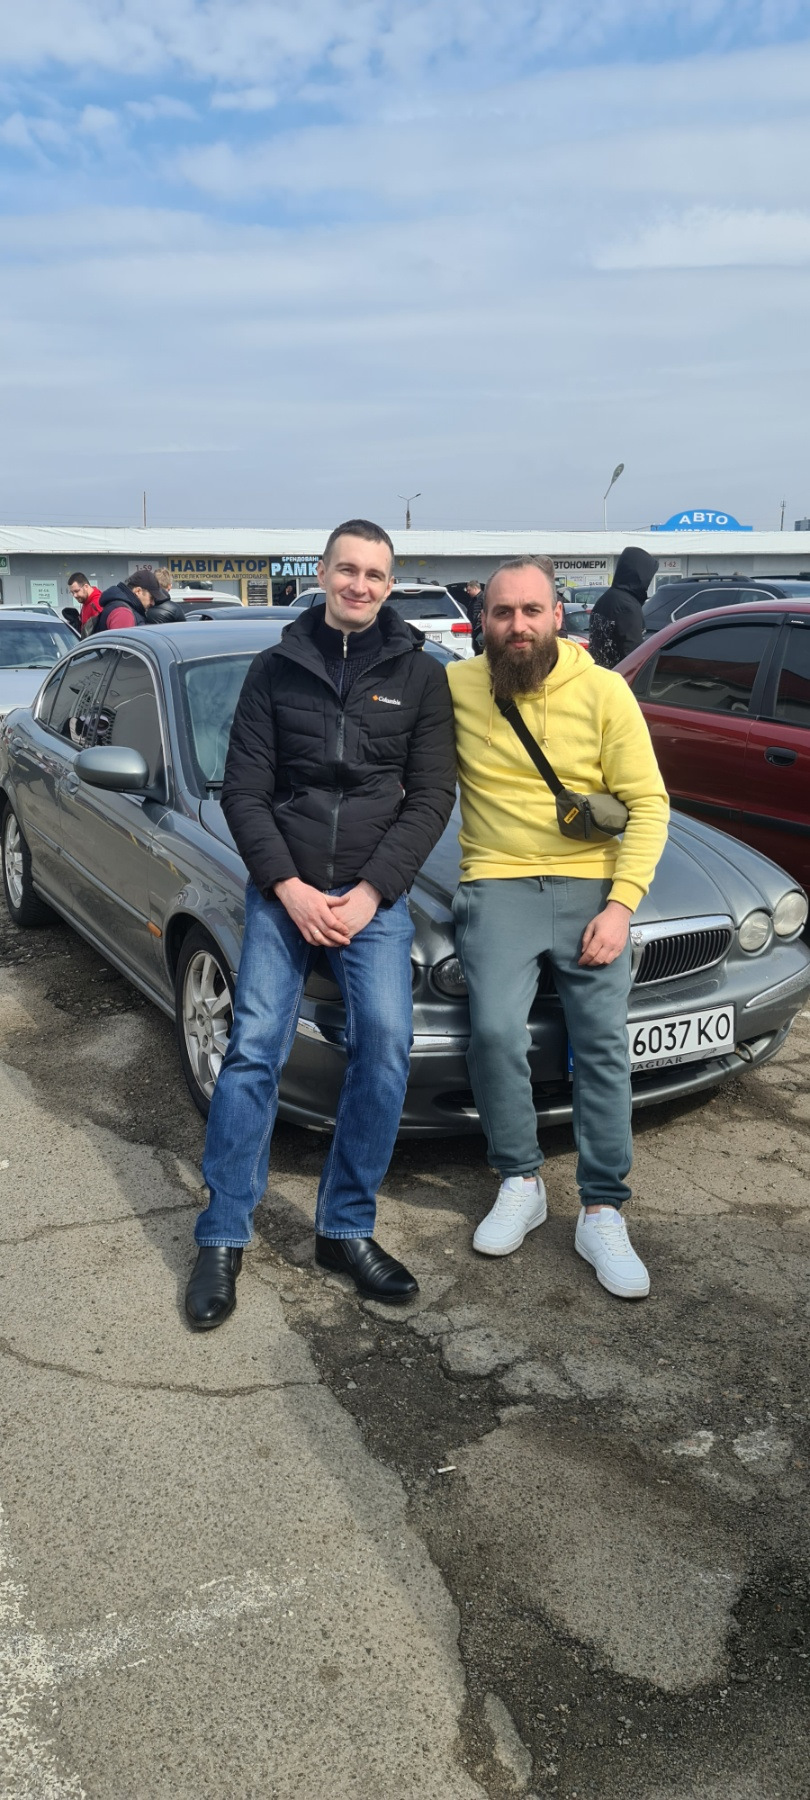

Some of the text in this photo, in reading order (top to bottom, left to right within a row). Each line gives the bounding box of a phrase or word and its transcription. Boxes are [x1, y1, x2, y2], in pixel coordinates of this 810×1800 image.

[679, 512, 728, 525] АВТО
[171, 559, 268, 572] НАВІГАТОР
[271, 562, 318, 576] РАМК
[554, 561, 606, 569] ВТОНОМЕРИ
[633, 1013, 731, 1056] 6037 KO
[631, 1056, 683, 1071] JAGUAR
